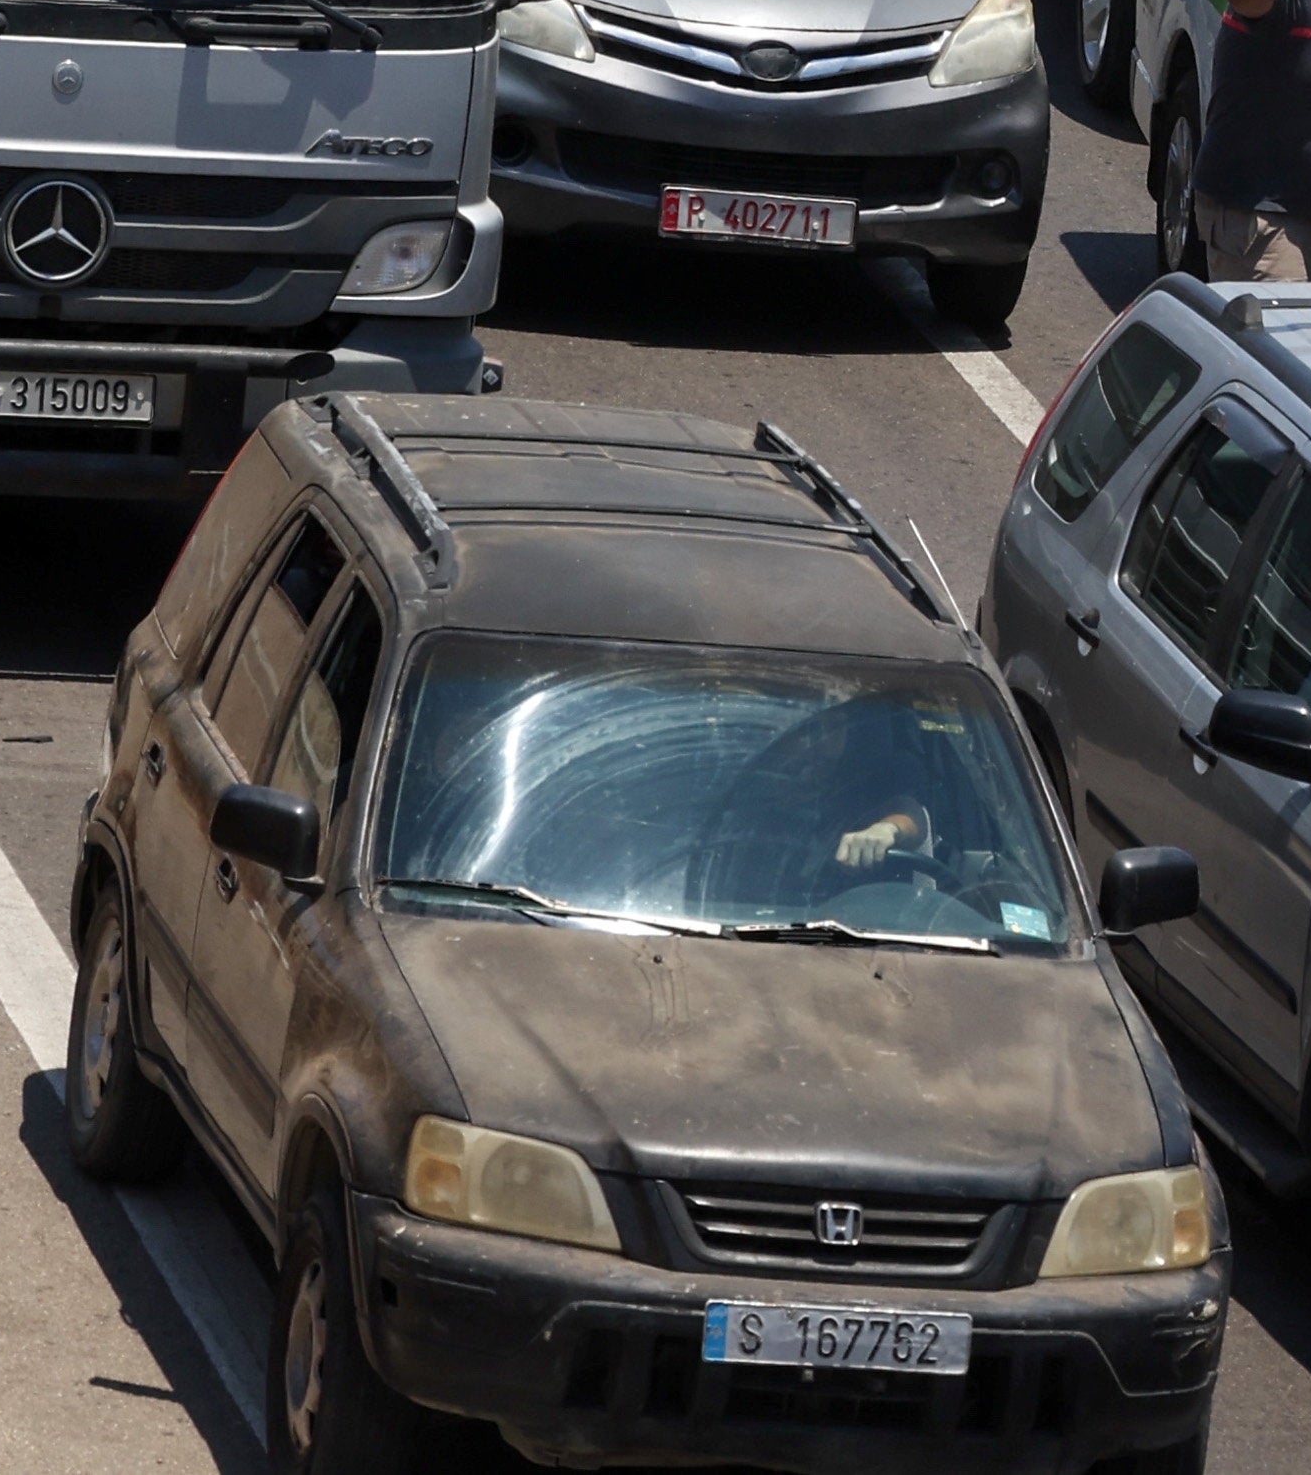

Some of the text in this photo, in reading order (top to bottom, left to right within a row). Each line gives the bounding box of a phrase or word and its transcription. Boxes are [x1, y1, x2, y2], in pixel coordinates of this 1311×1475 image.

[306, 128, 434, 156] ATEGO
[687, 194, 831, 240] P 402711
[9, 375, 131, 415] 315009
[739, 1313, 763, 1356] S
